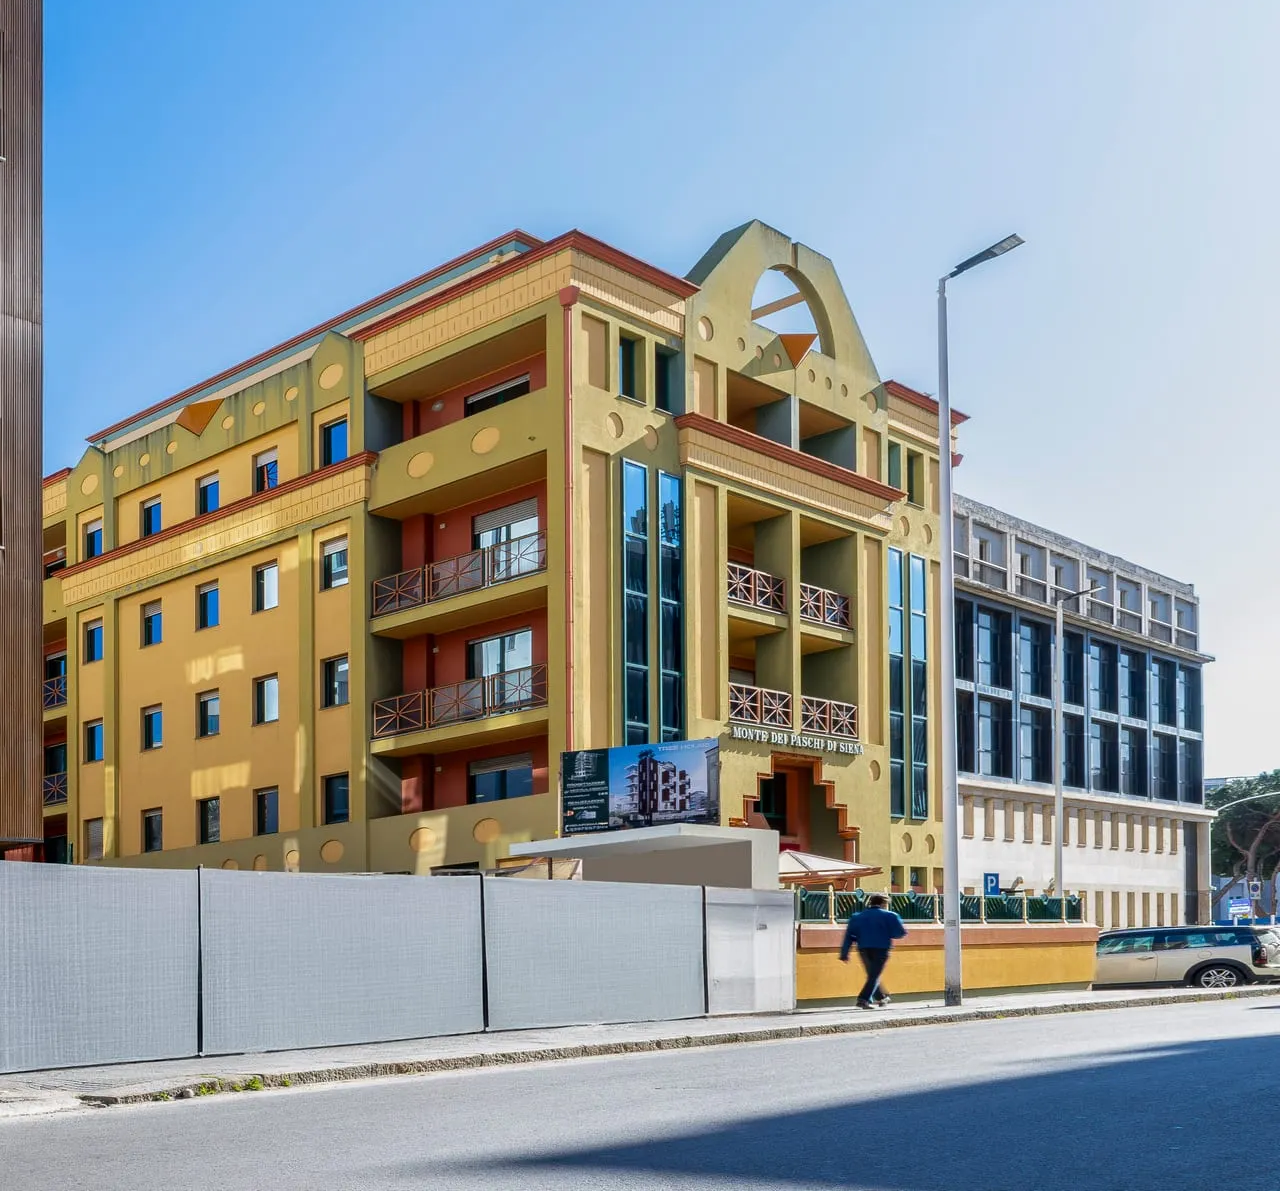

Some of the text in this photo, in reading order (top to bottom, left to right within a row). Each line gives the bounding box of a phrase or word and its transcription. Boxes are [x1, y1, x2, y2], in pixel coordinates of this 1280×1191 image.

[732, 726, 865, 755] MONTE DEI PASCHI DI SIENA
[987, 875, 996, 893] P
